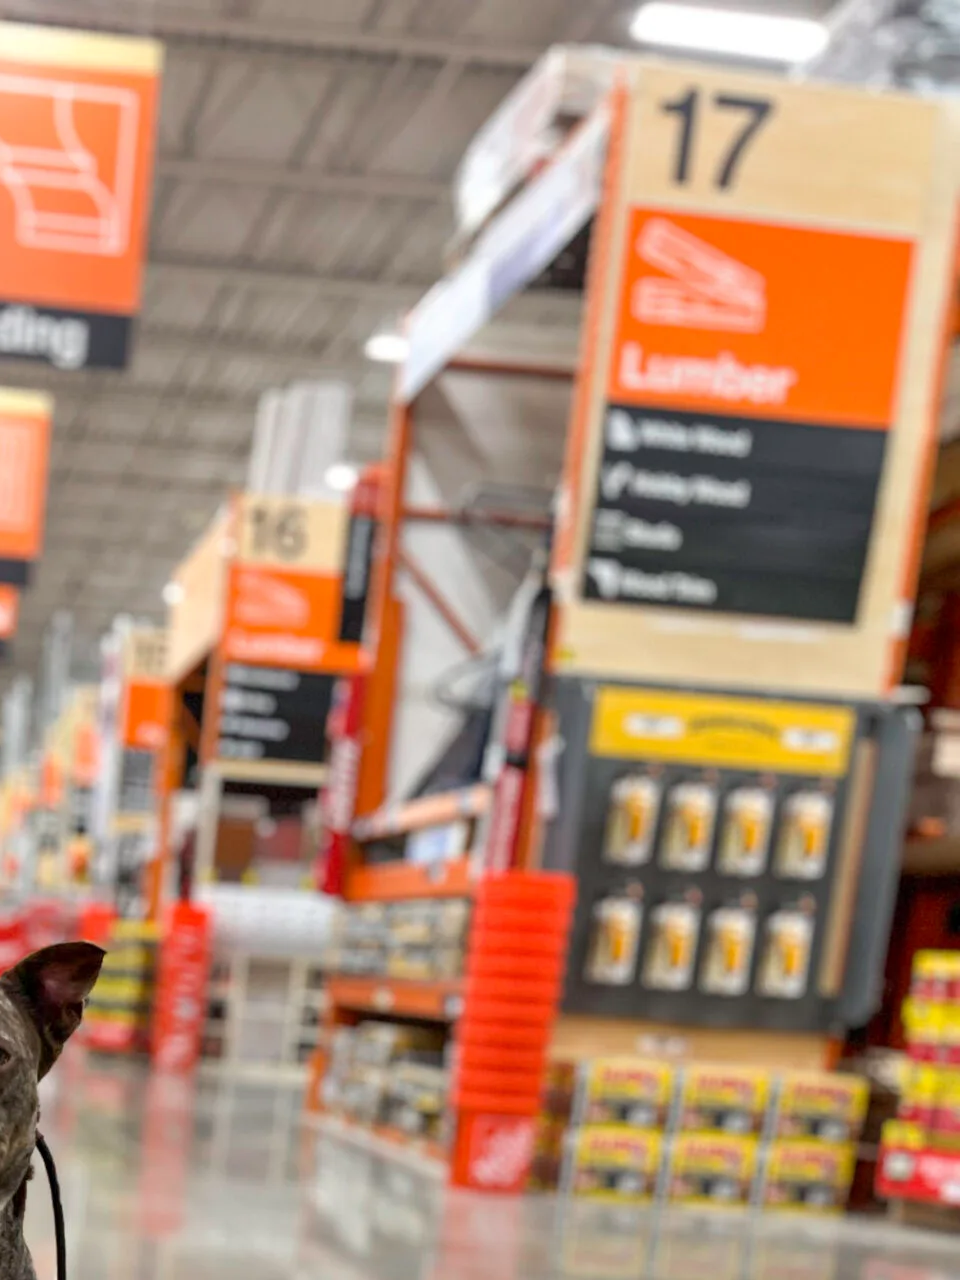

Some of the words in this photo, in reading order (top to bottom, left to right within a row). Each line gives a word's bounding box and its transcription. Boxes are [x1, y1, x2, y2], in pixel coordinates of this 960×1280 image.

[659, 86, 775, 192] 17
[619, 342, 797, 404] Lumber
[252, 503, 306, 562] 16
